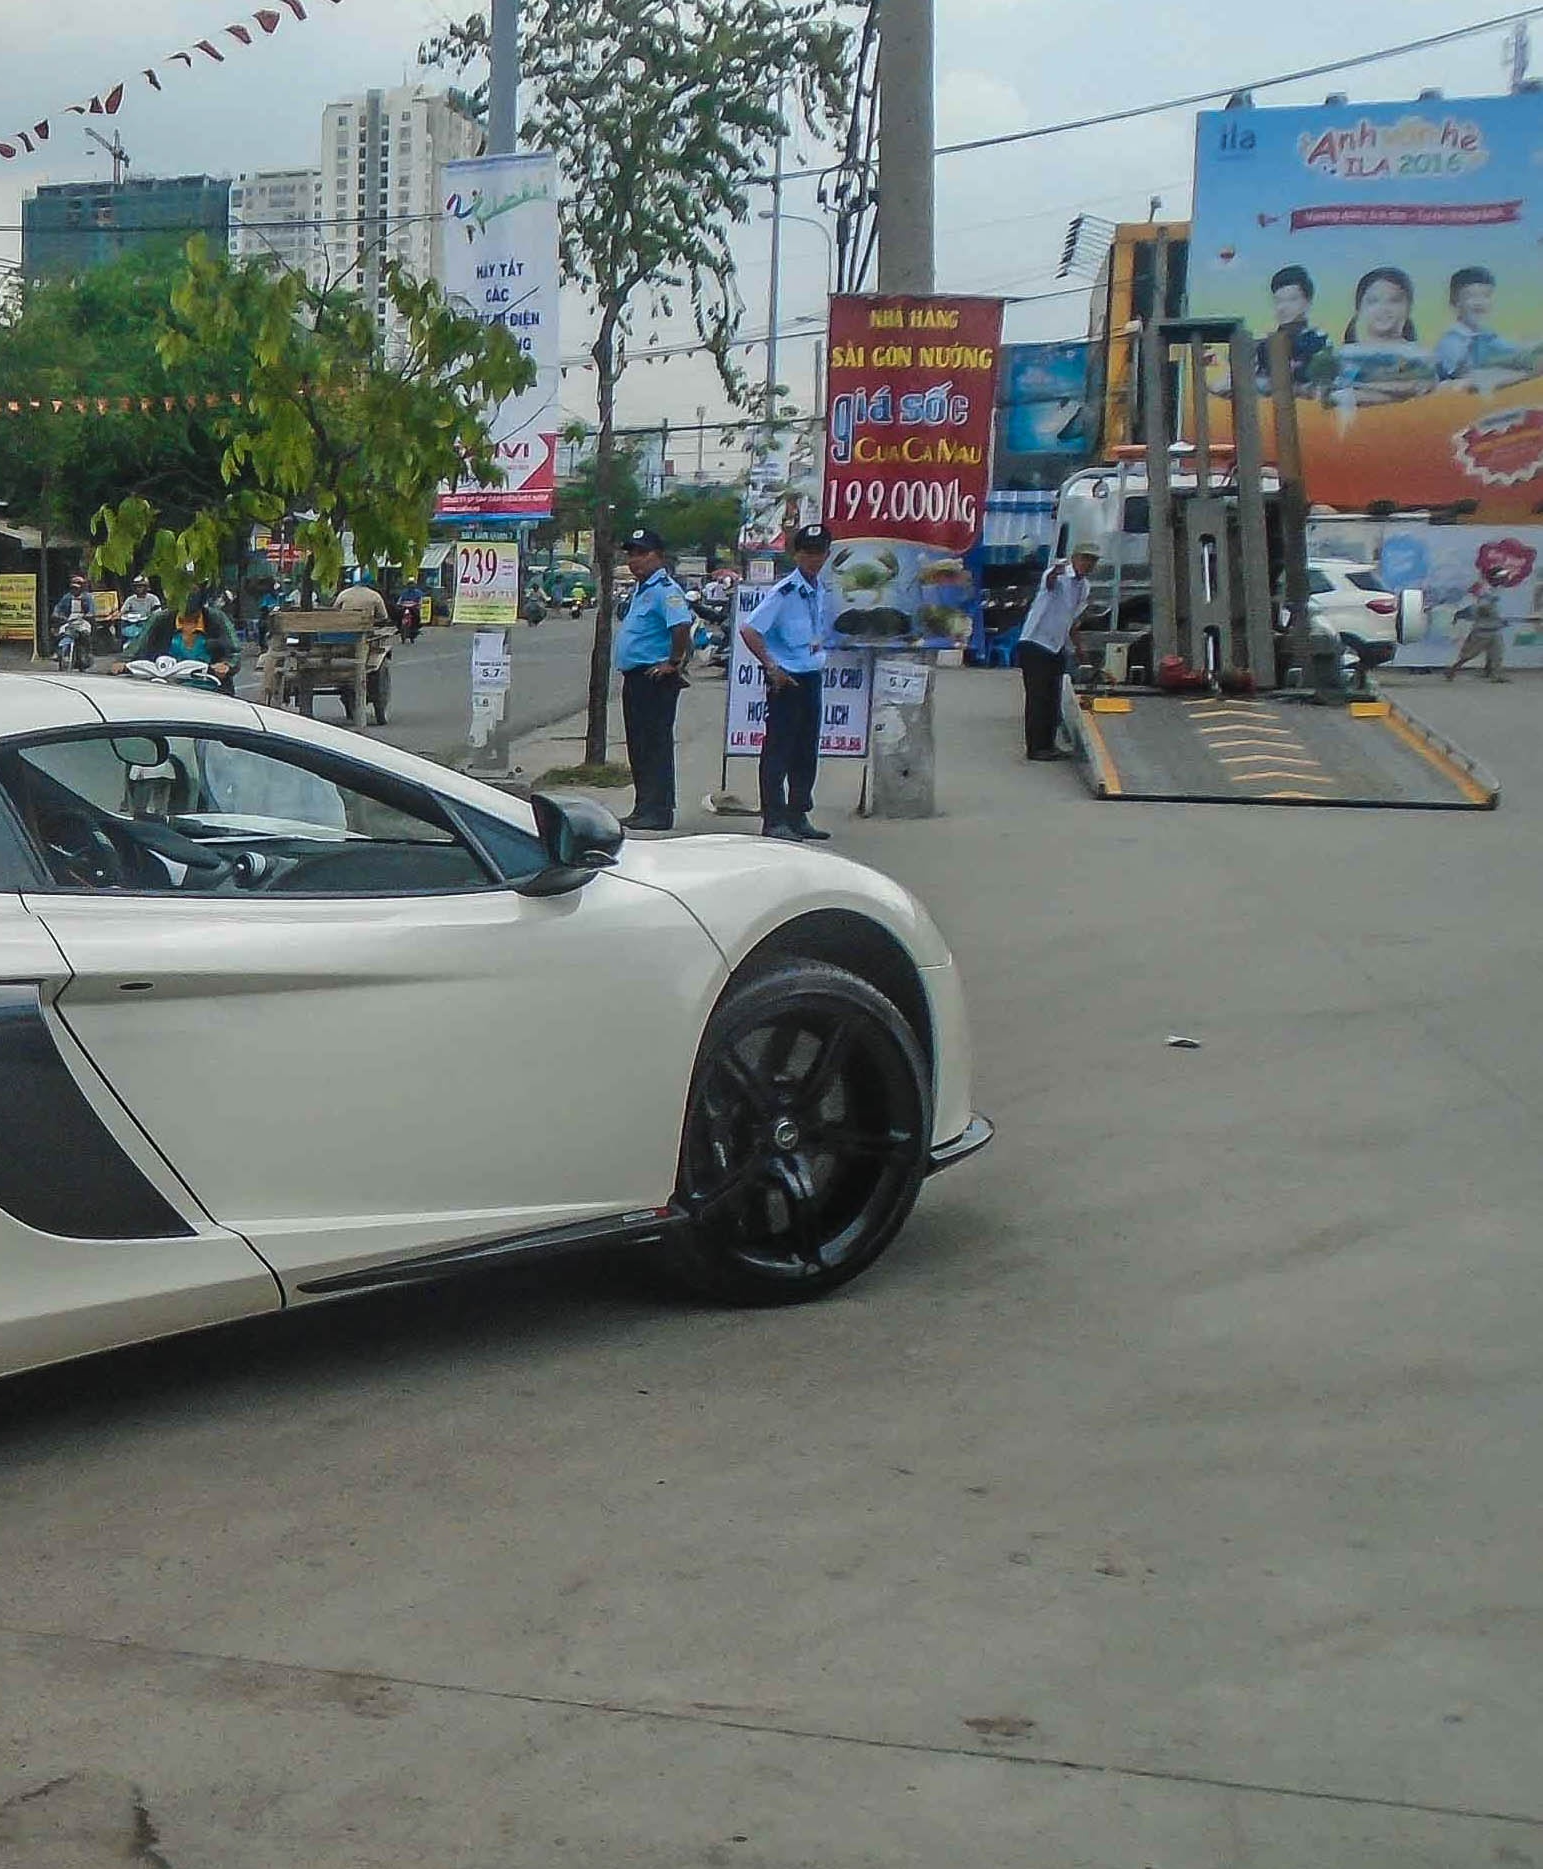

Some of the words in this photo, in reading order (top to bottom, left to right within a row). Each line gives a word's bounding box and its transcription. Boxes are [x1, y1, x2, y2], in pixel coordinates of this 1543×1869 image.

[1399, 152, 1464, 175] 2016
[831, 385, 894, 464] giá
[459, 547, 498, 585] 239
